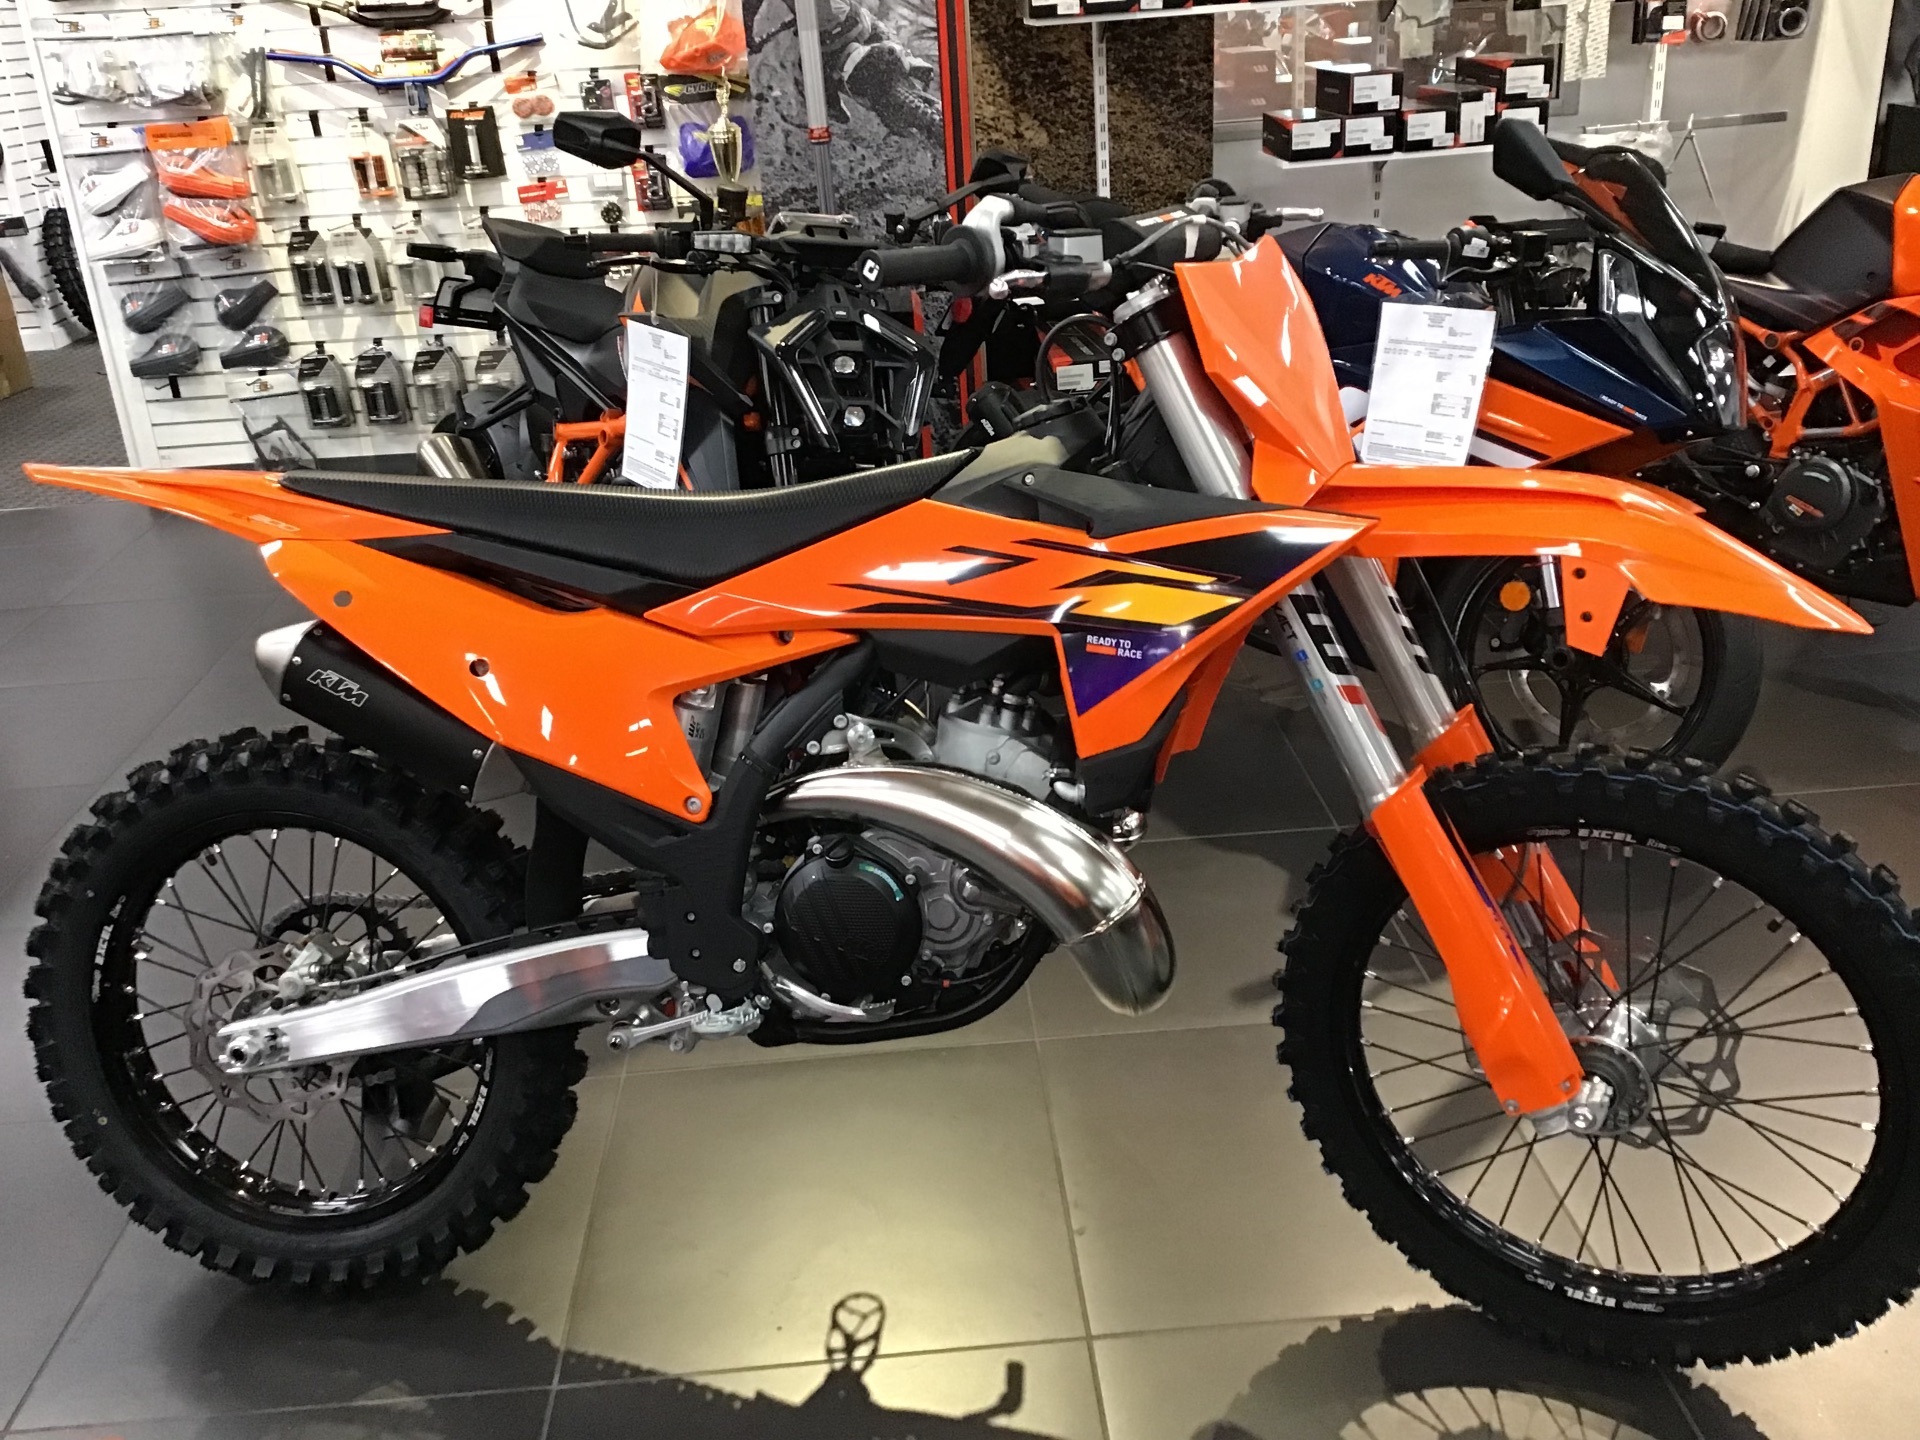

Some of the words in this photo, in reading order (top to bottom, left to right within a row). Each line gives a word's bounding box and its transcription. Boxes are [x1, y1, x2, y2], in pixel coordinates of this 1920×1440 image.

[1362, 273, 1402, 298] KTM
[1086, 634, 1117, 647] READY
[1118, 639, 1131, 649] TO
[1117, 647, 1143, 660] RACE
[306, 668, 370, 708] KTM
[1577, 828, 1637, 843] EXCEL
[467, 1084, 489, 1127] EXCEL
